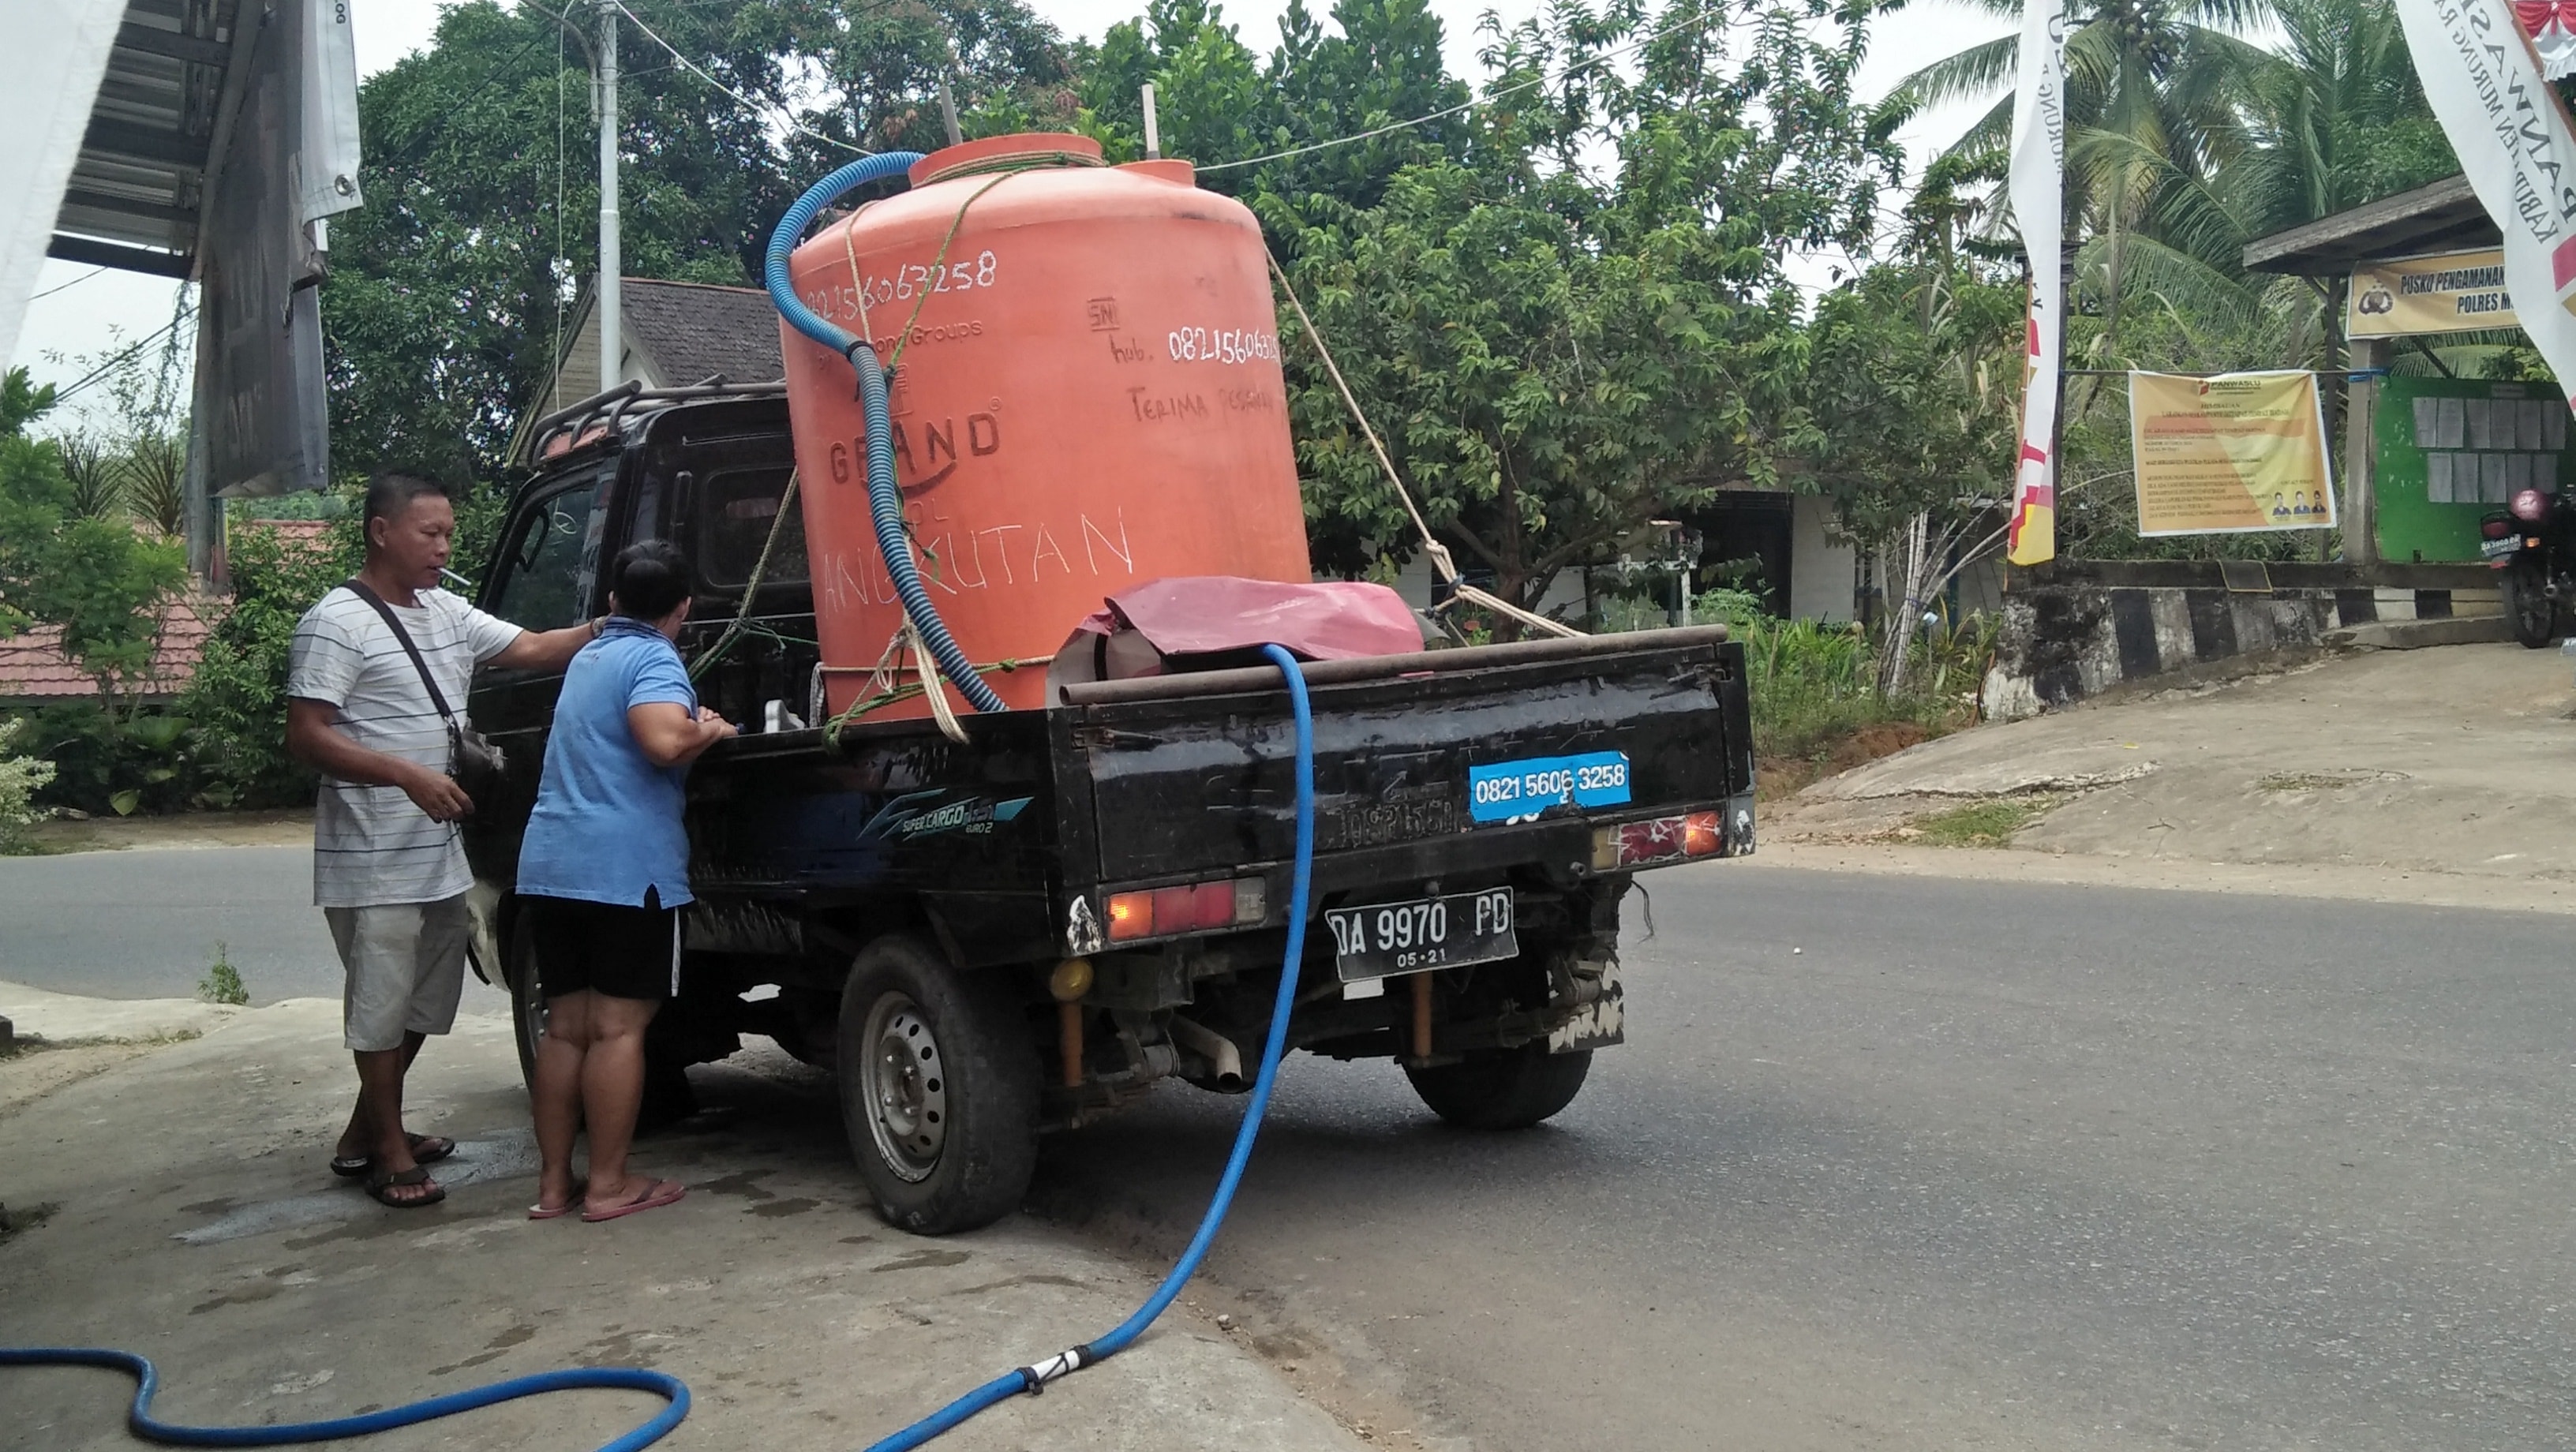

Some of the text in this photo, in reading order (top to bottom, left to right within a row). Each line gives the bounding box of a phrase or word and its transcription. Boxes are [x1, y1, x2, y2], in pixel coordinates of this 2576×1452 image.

[2400, 273, 2436, 295] POSKO
[2456, 293, 2499, 315] POLRES
[1125, 386, 1211, 423] TERIMA
[1475, 763, 1627, 805] 0821 5606 3258
[926, 804, 965, 829] CARGO
[985, 821, 994, 834] 2
[1330, 892, 1510, 956] DA 9970 PD
